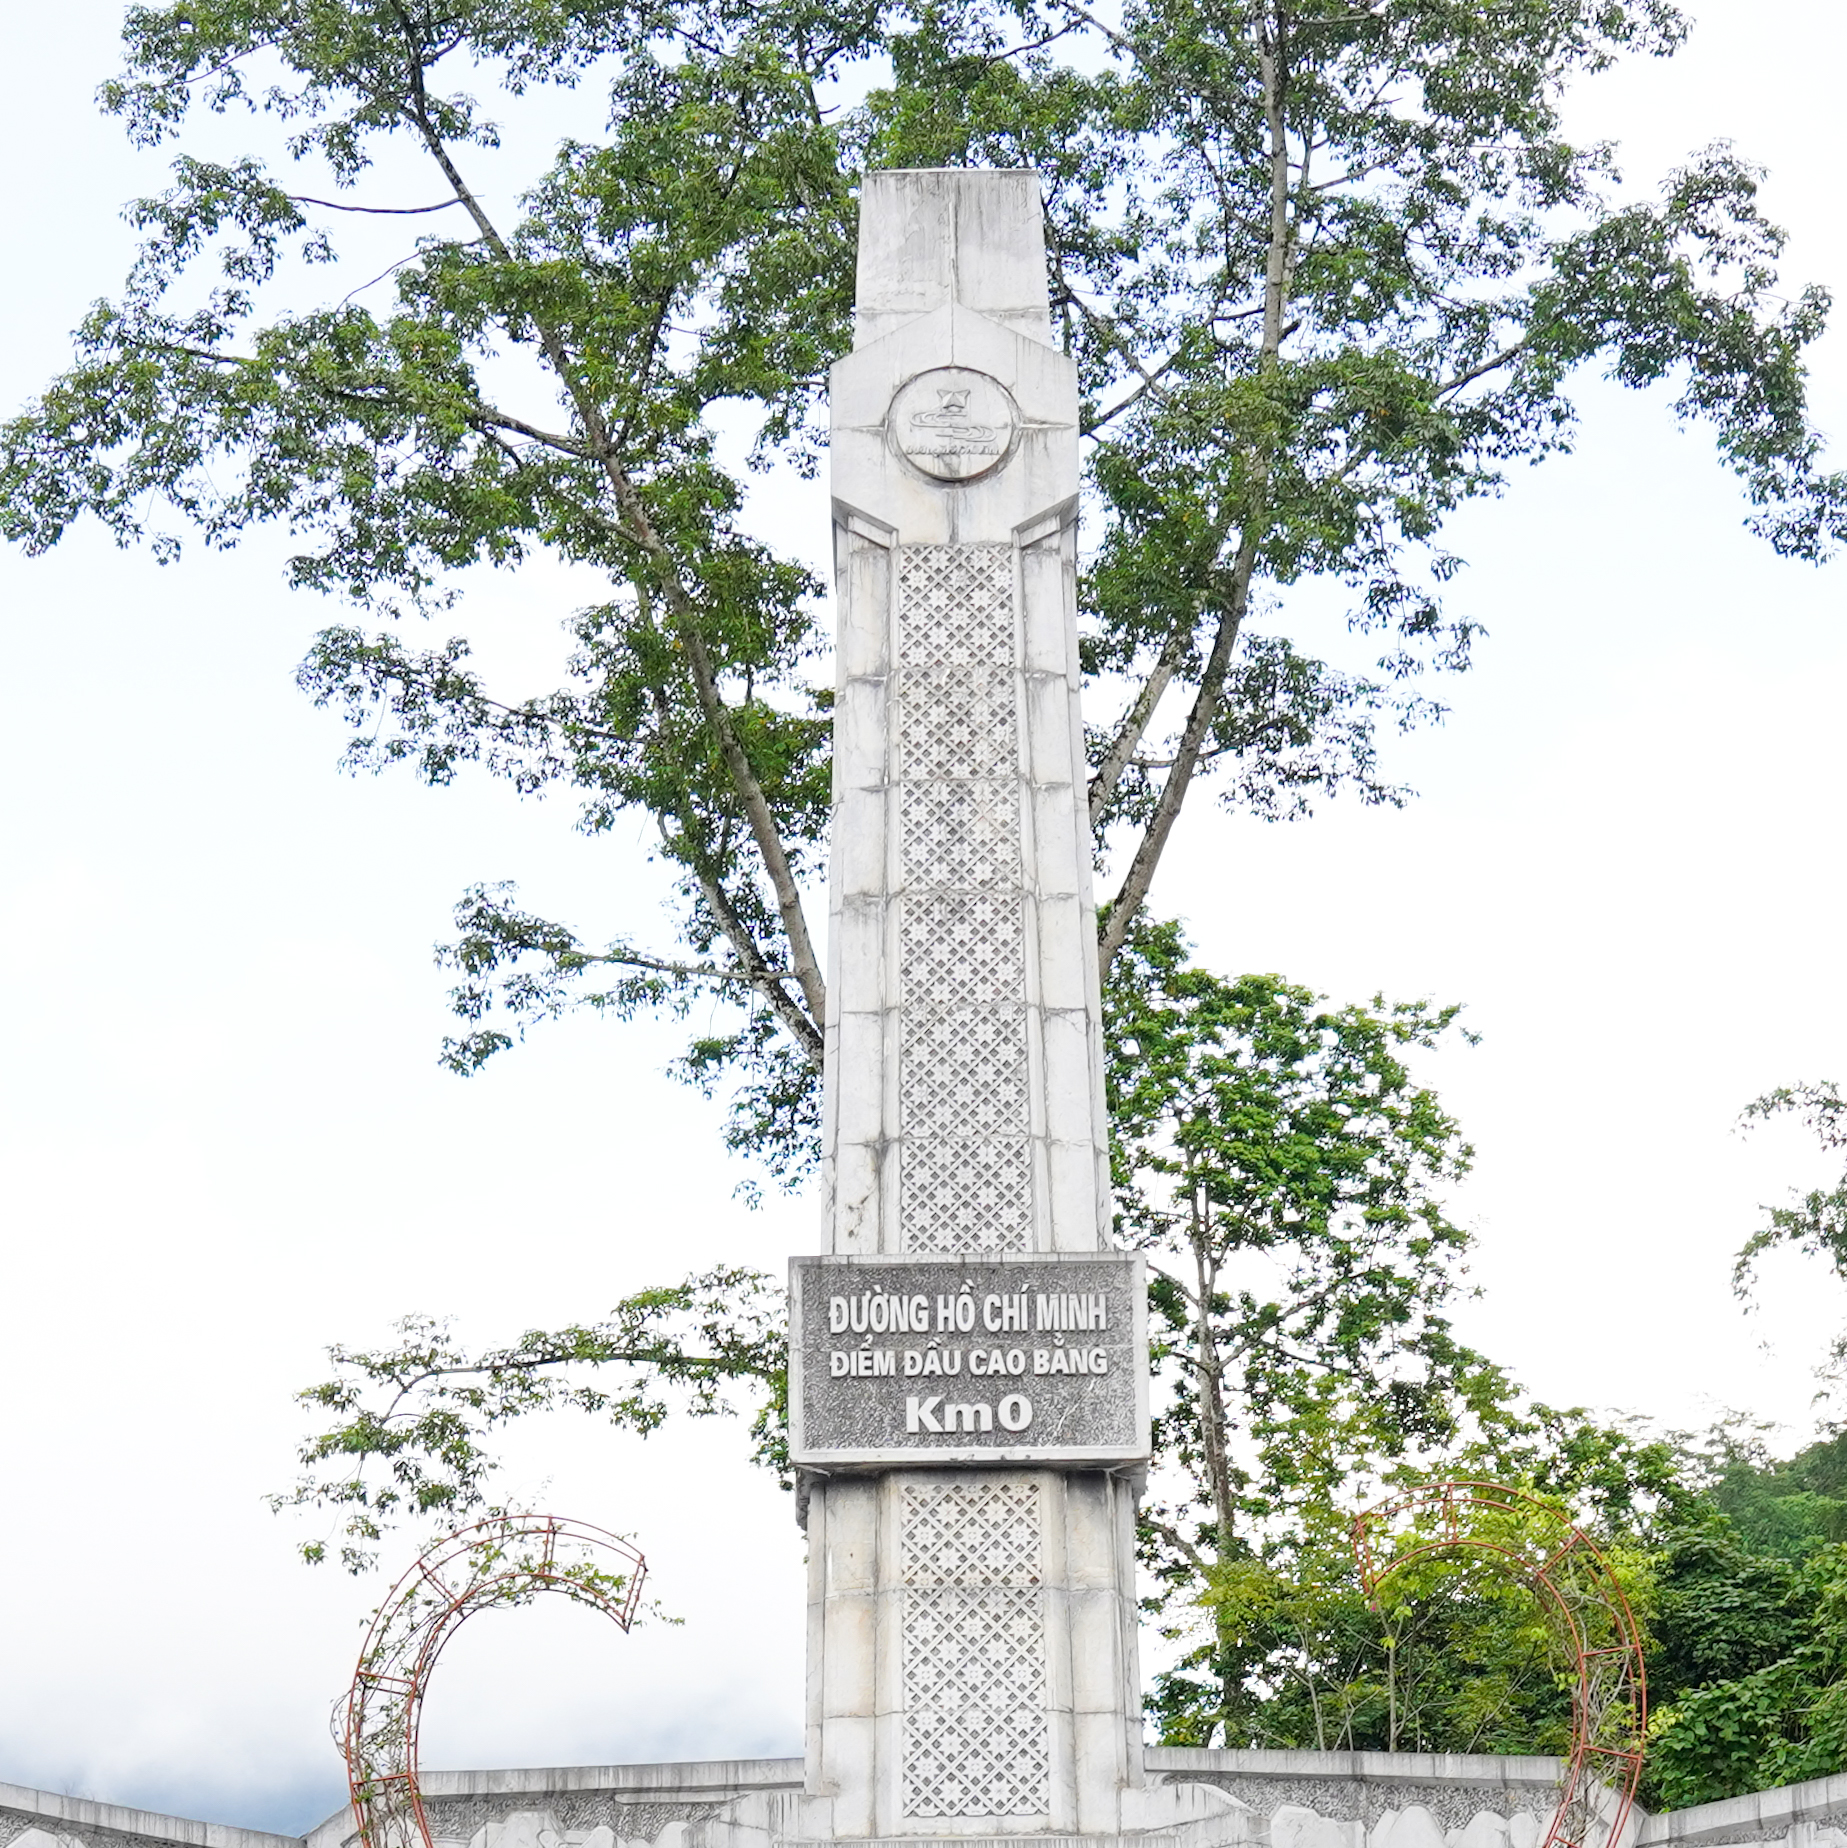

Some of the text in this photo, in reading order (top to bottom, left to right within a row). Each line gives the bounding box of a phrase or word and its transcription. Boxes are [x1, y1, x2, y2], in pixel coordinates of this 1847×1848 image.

[829, 1279, 1106, 1333] ĐƯỜNG HỒ CHÍ MINH
[829, 1332, 1108, 1377] ĐIỂM ĐẦU CAO BẰNG
